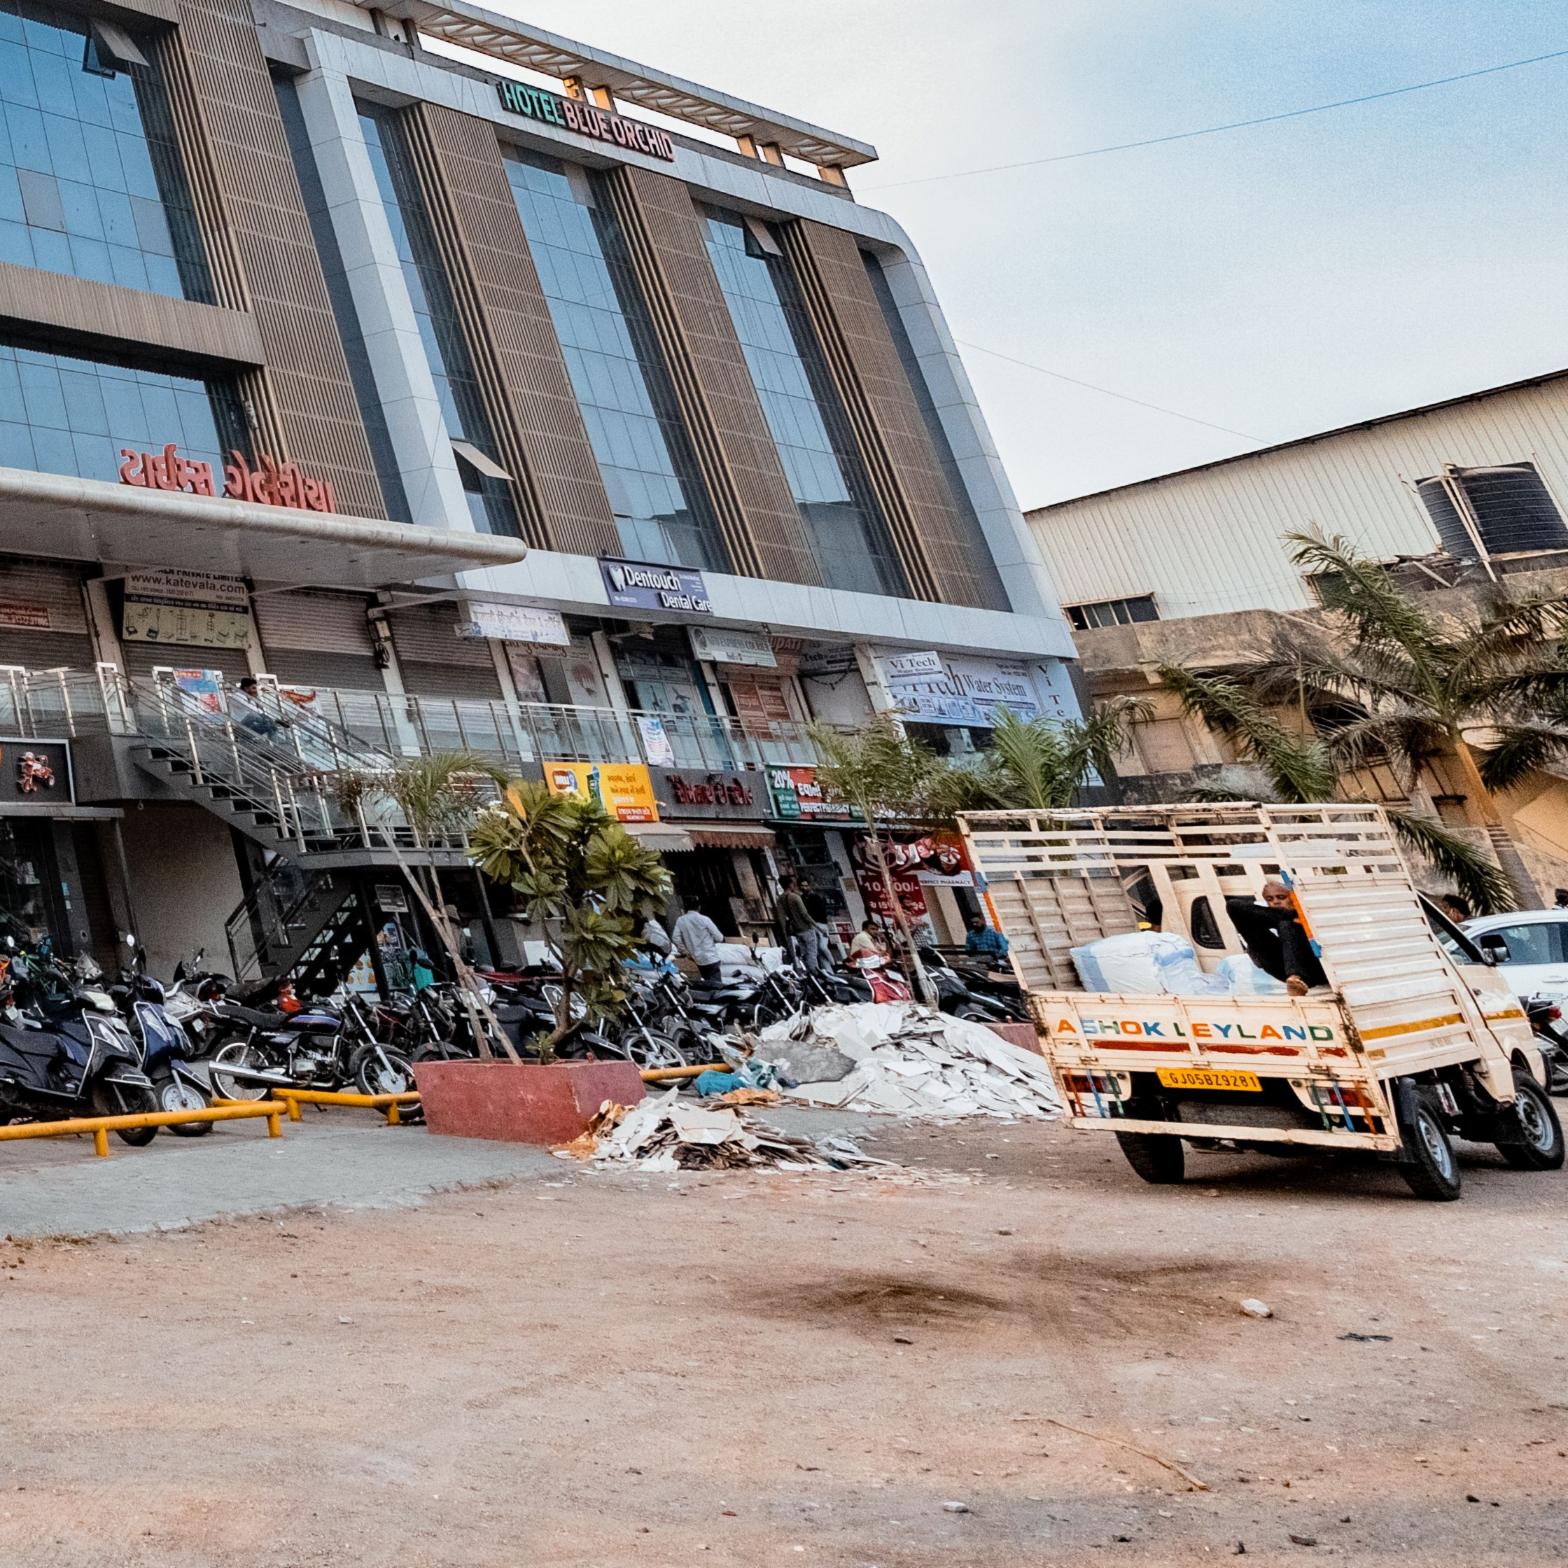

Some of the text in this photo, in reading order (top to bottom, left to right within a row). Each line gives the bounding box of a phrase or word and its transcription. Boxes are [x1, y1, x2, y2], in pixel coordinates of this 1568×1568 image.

[498, 80, 676, 161] HOTEL BLUE ORCHID
[130, 574, 246, 595] www.katevala.com
[623, 565, 681, 592] Dentouch
[660, 591, 713, 613] Dental Care
[906, 657, 937, 669] Tech
[964, 673, 1028, 700] Water System
[1056, 1017, 1334, 1042] ASHOK LEYLAND
[1168, 1070, 1258, 1089] GJ05BZ9281
